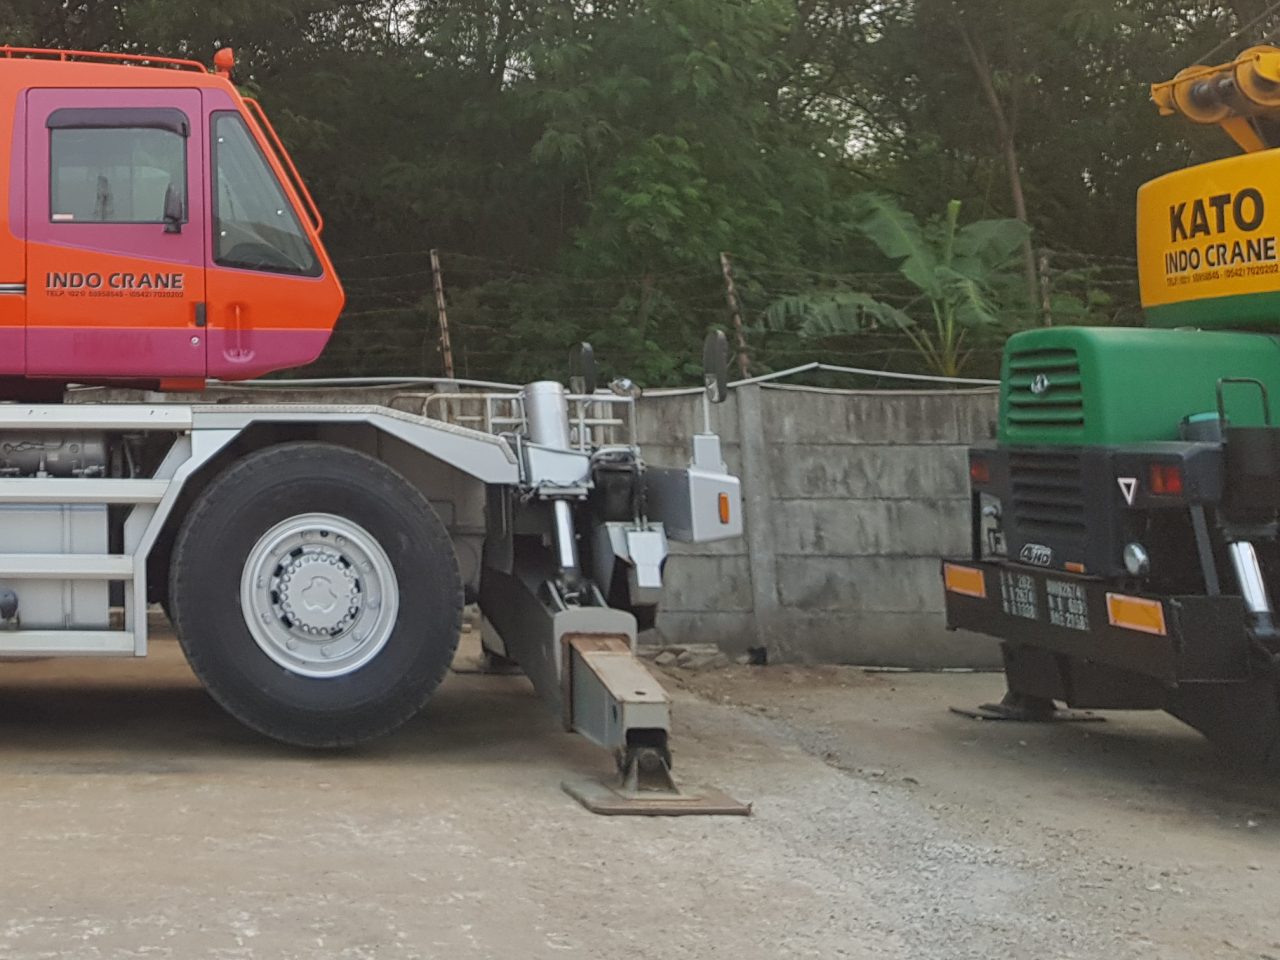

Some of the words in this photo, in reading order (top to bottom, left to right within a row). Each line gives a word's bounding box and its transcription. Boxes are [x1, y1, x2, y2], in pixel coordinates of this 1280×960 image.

[1169, 187, 1264, 243] KATO
[1164, 246, 1201, 274] INDO
[1205, 236, 1277, 267] CRANE
[45, 271, 103, 289] INDO
[108, 272, 185, 289] CRANE
